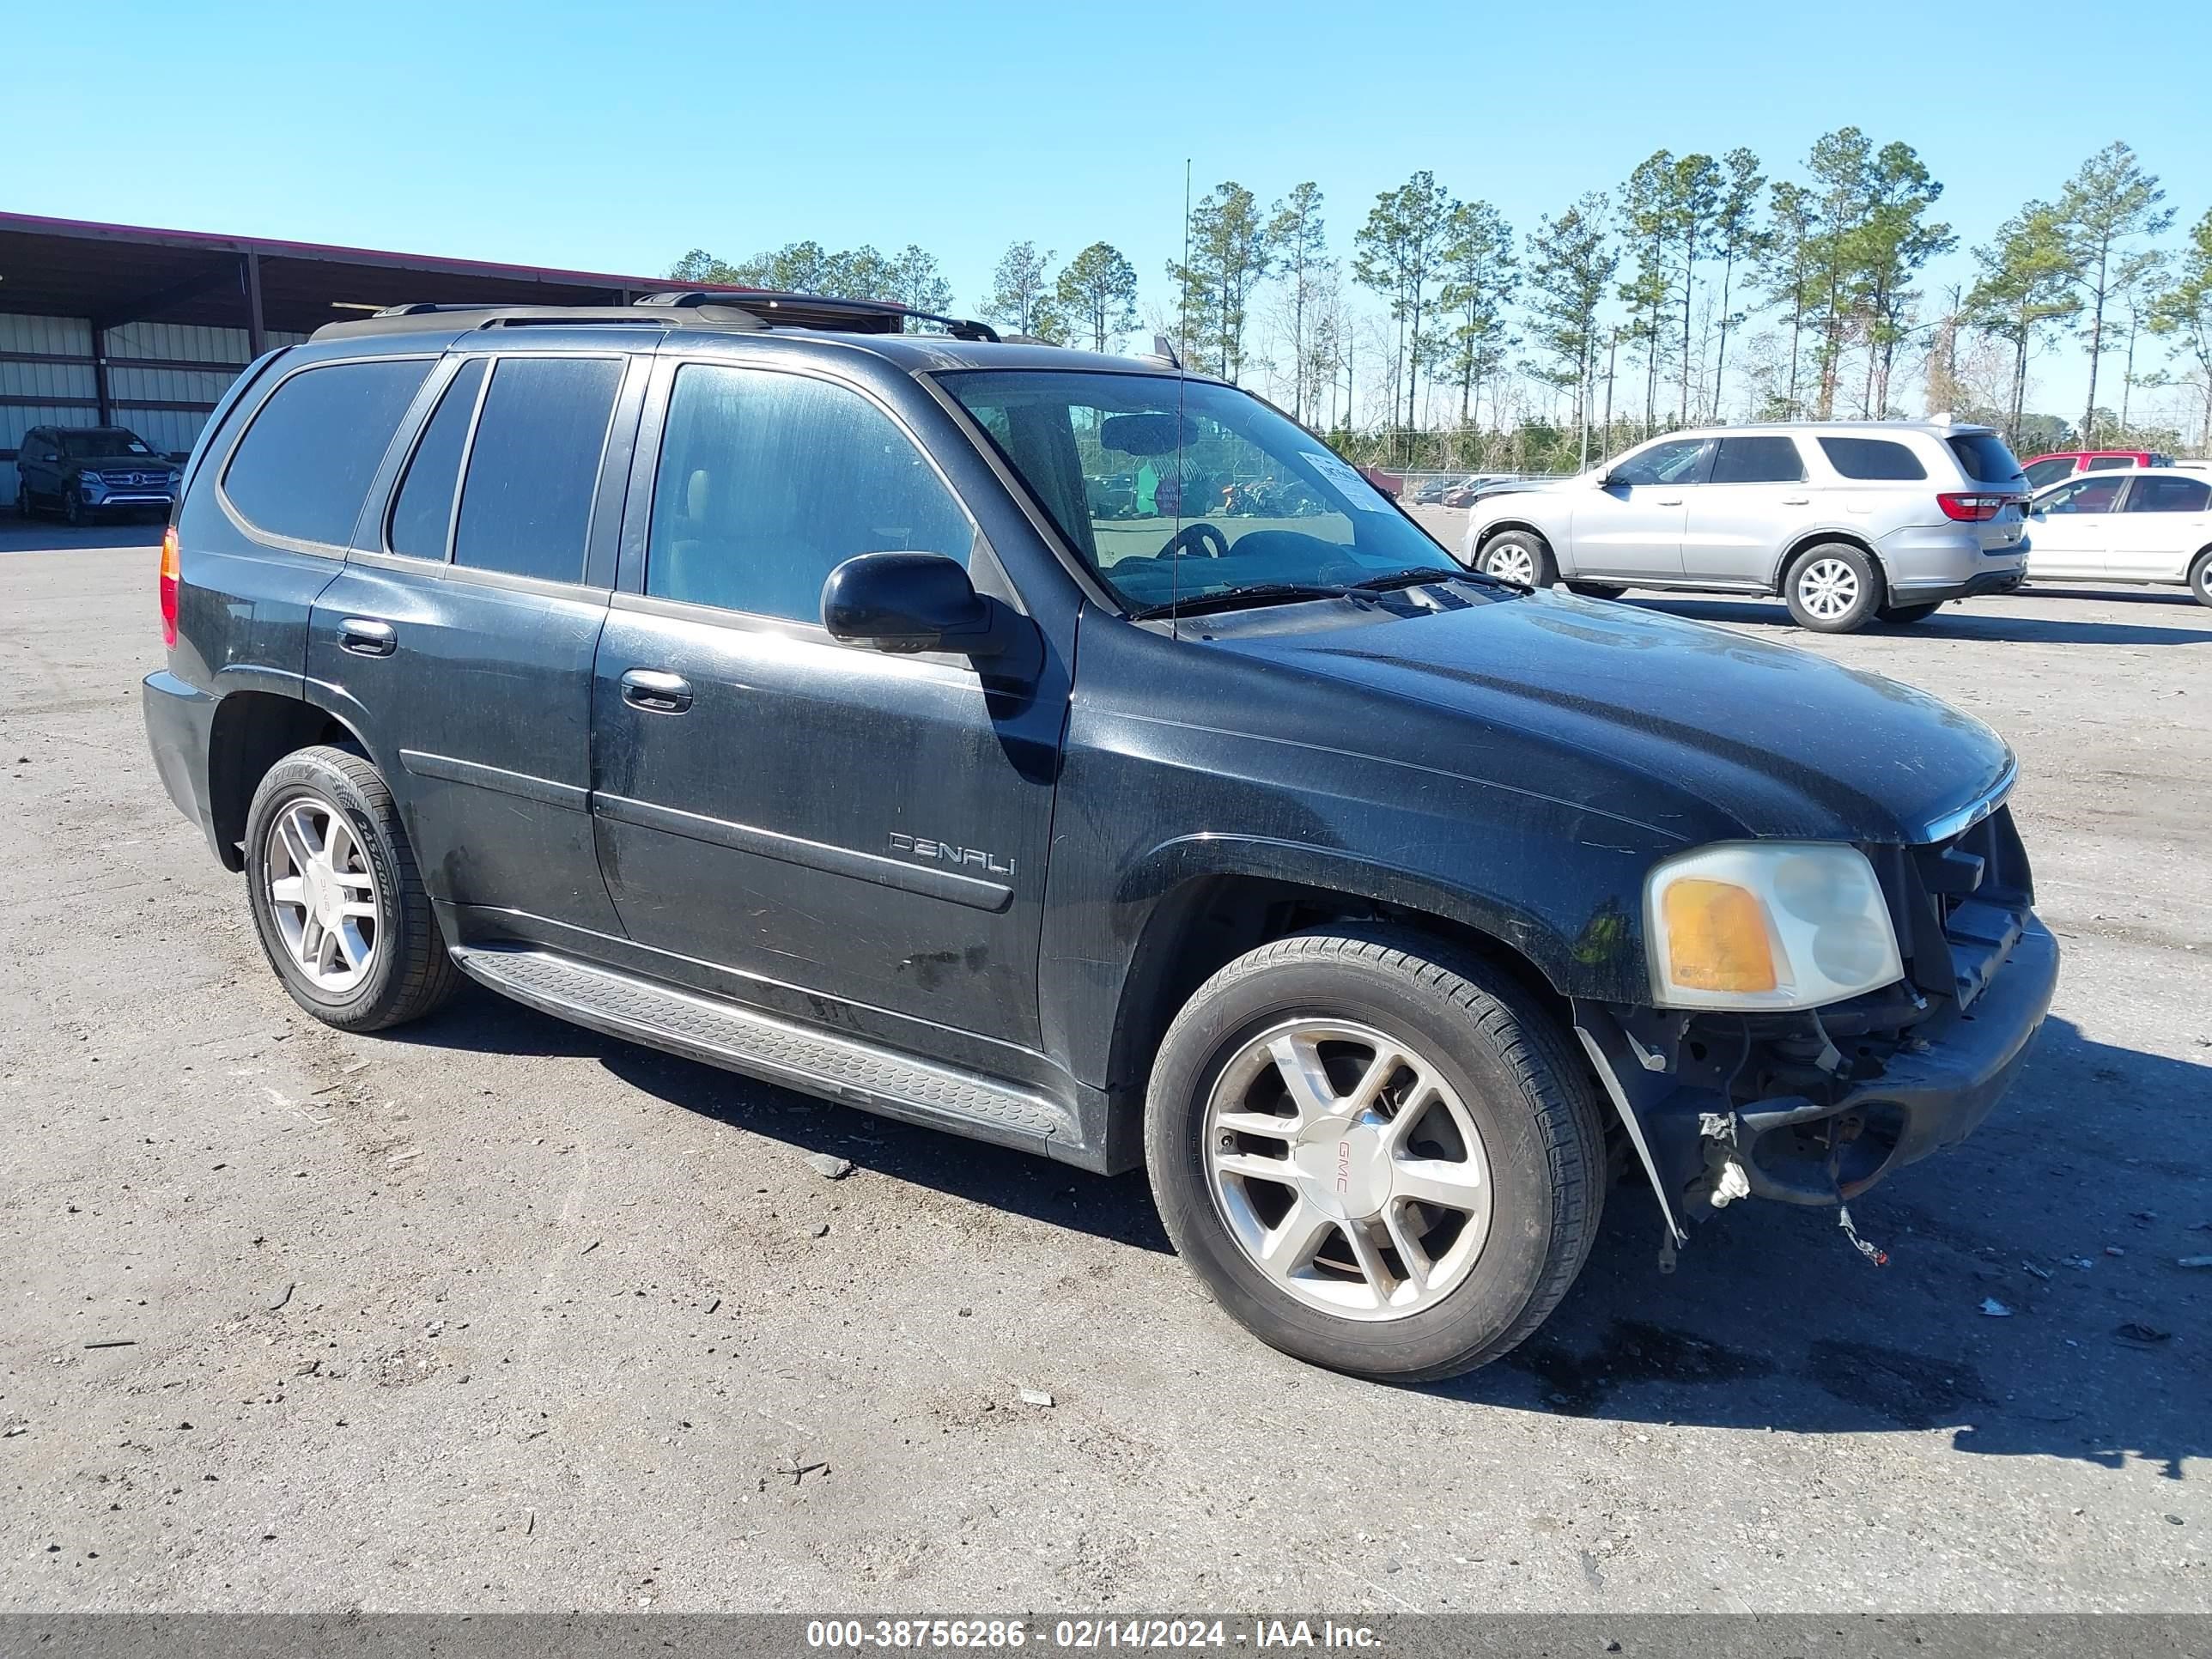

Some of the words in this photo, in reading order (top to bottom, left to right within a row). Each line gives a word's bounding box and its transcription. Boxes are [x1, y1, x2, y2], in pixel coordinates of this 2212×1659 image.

[357, 821, 393, 919] 245/60R18
[890, 831, 1016, 876] DENALI
[1336, 1141, 1350, 1194] GMC
